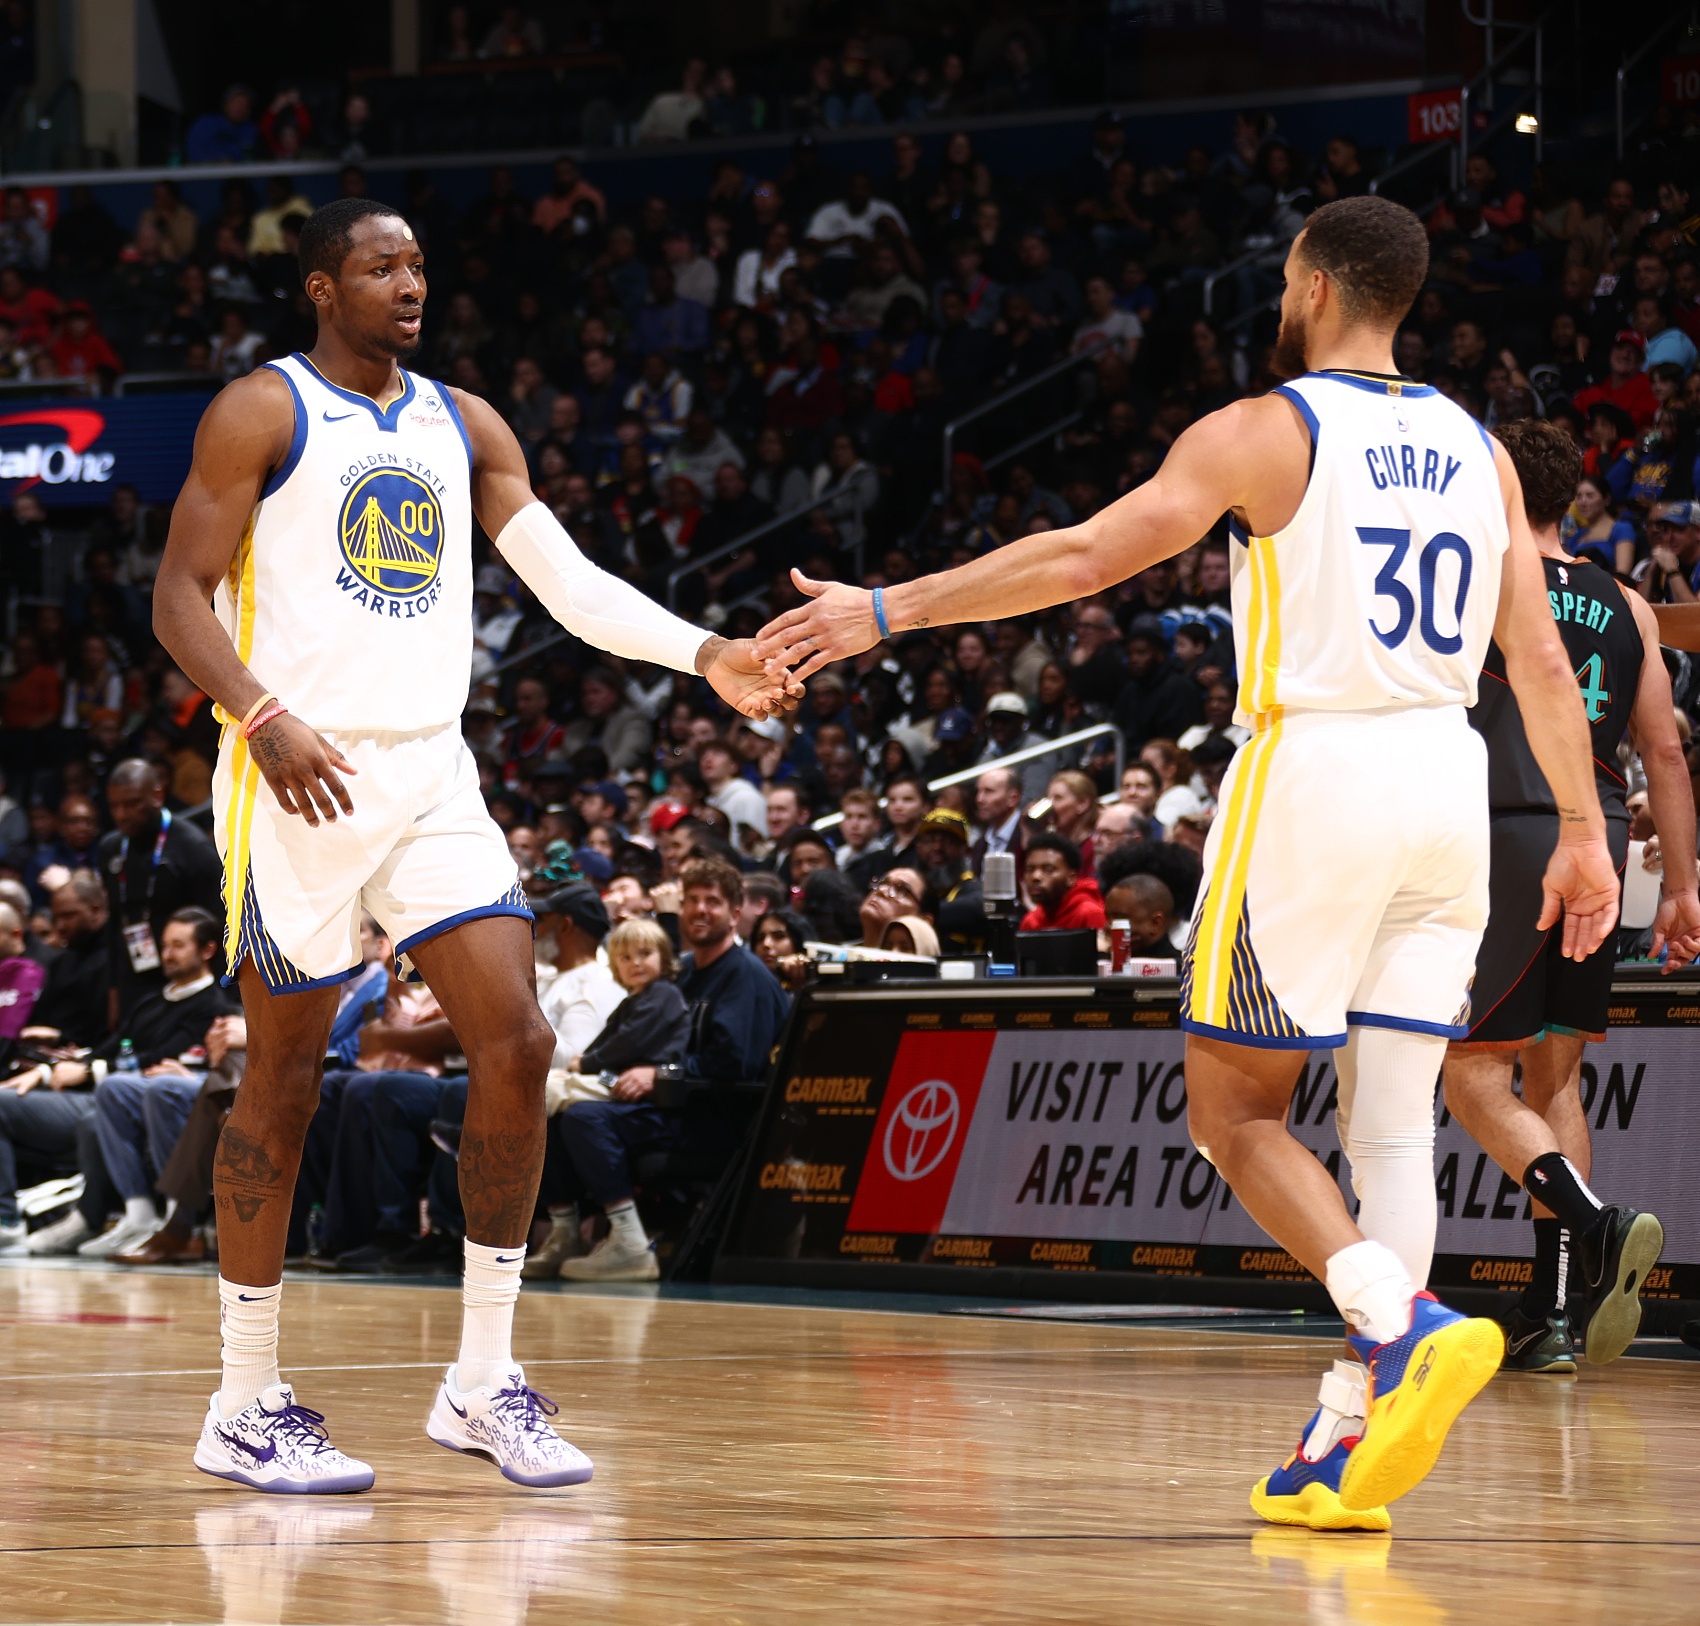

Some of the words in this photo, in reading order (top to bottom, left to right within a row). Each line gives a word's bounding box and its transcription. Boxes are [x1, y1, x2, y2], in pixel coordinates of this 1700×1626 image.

[1419, 104, 1461, 134] 103
[409, 413, 450, 426] Rakuten
[340, 453, 398, 487] GOLDEN
[406, 457, 447, 497] STATE
[1365, 444, 1462, 496] CURRY
[400, 500, 434, 537] 00
[335, 565, 442, 618] WARRIORS
[1354, 526, 1473, 655] 30
[1575, 652, 1611, 725] 4
[1006, 1061, 1123, 1122] VISIT
[1015, 1144, 1138, 1207] AREA
[1470, 1260, 1533, 1283] CARma
